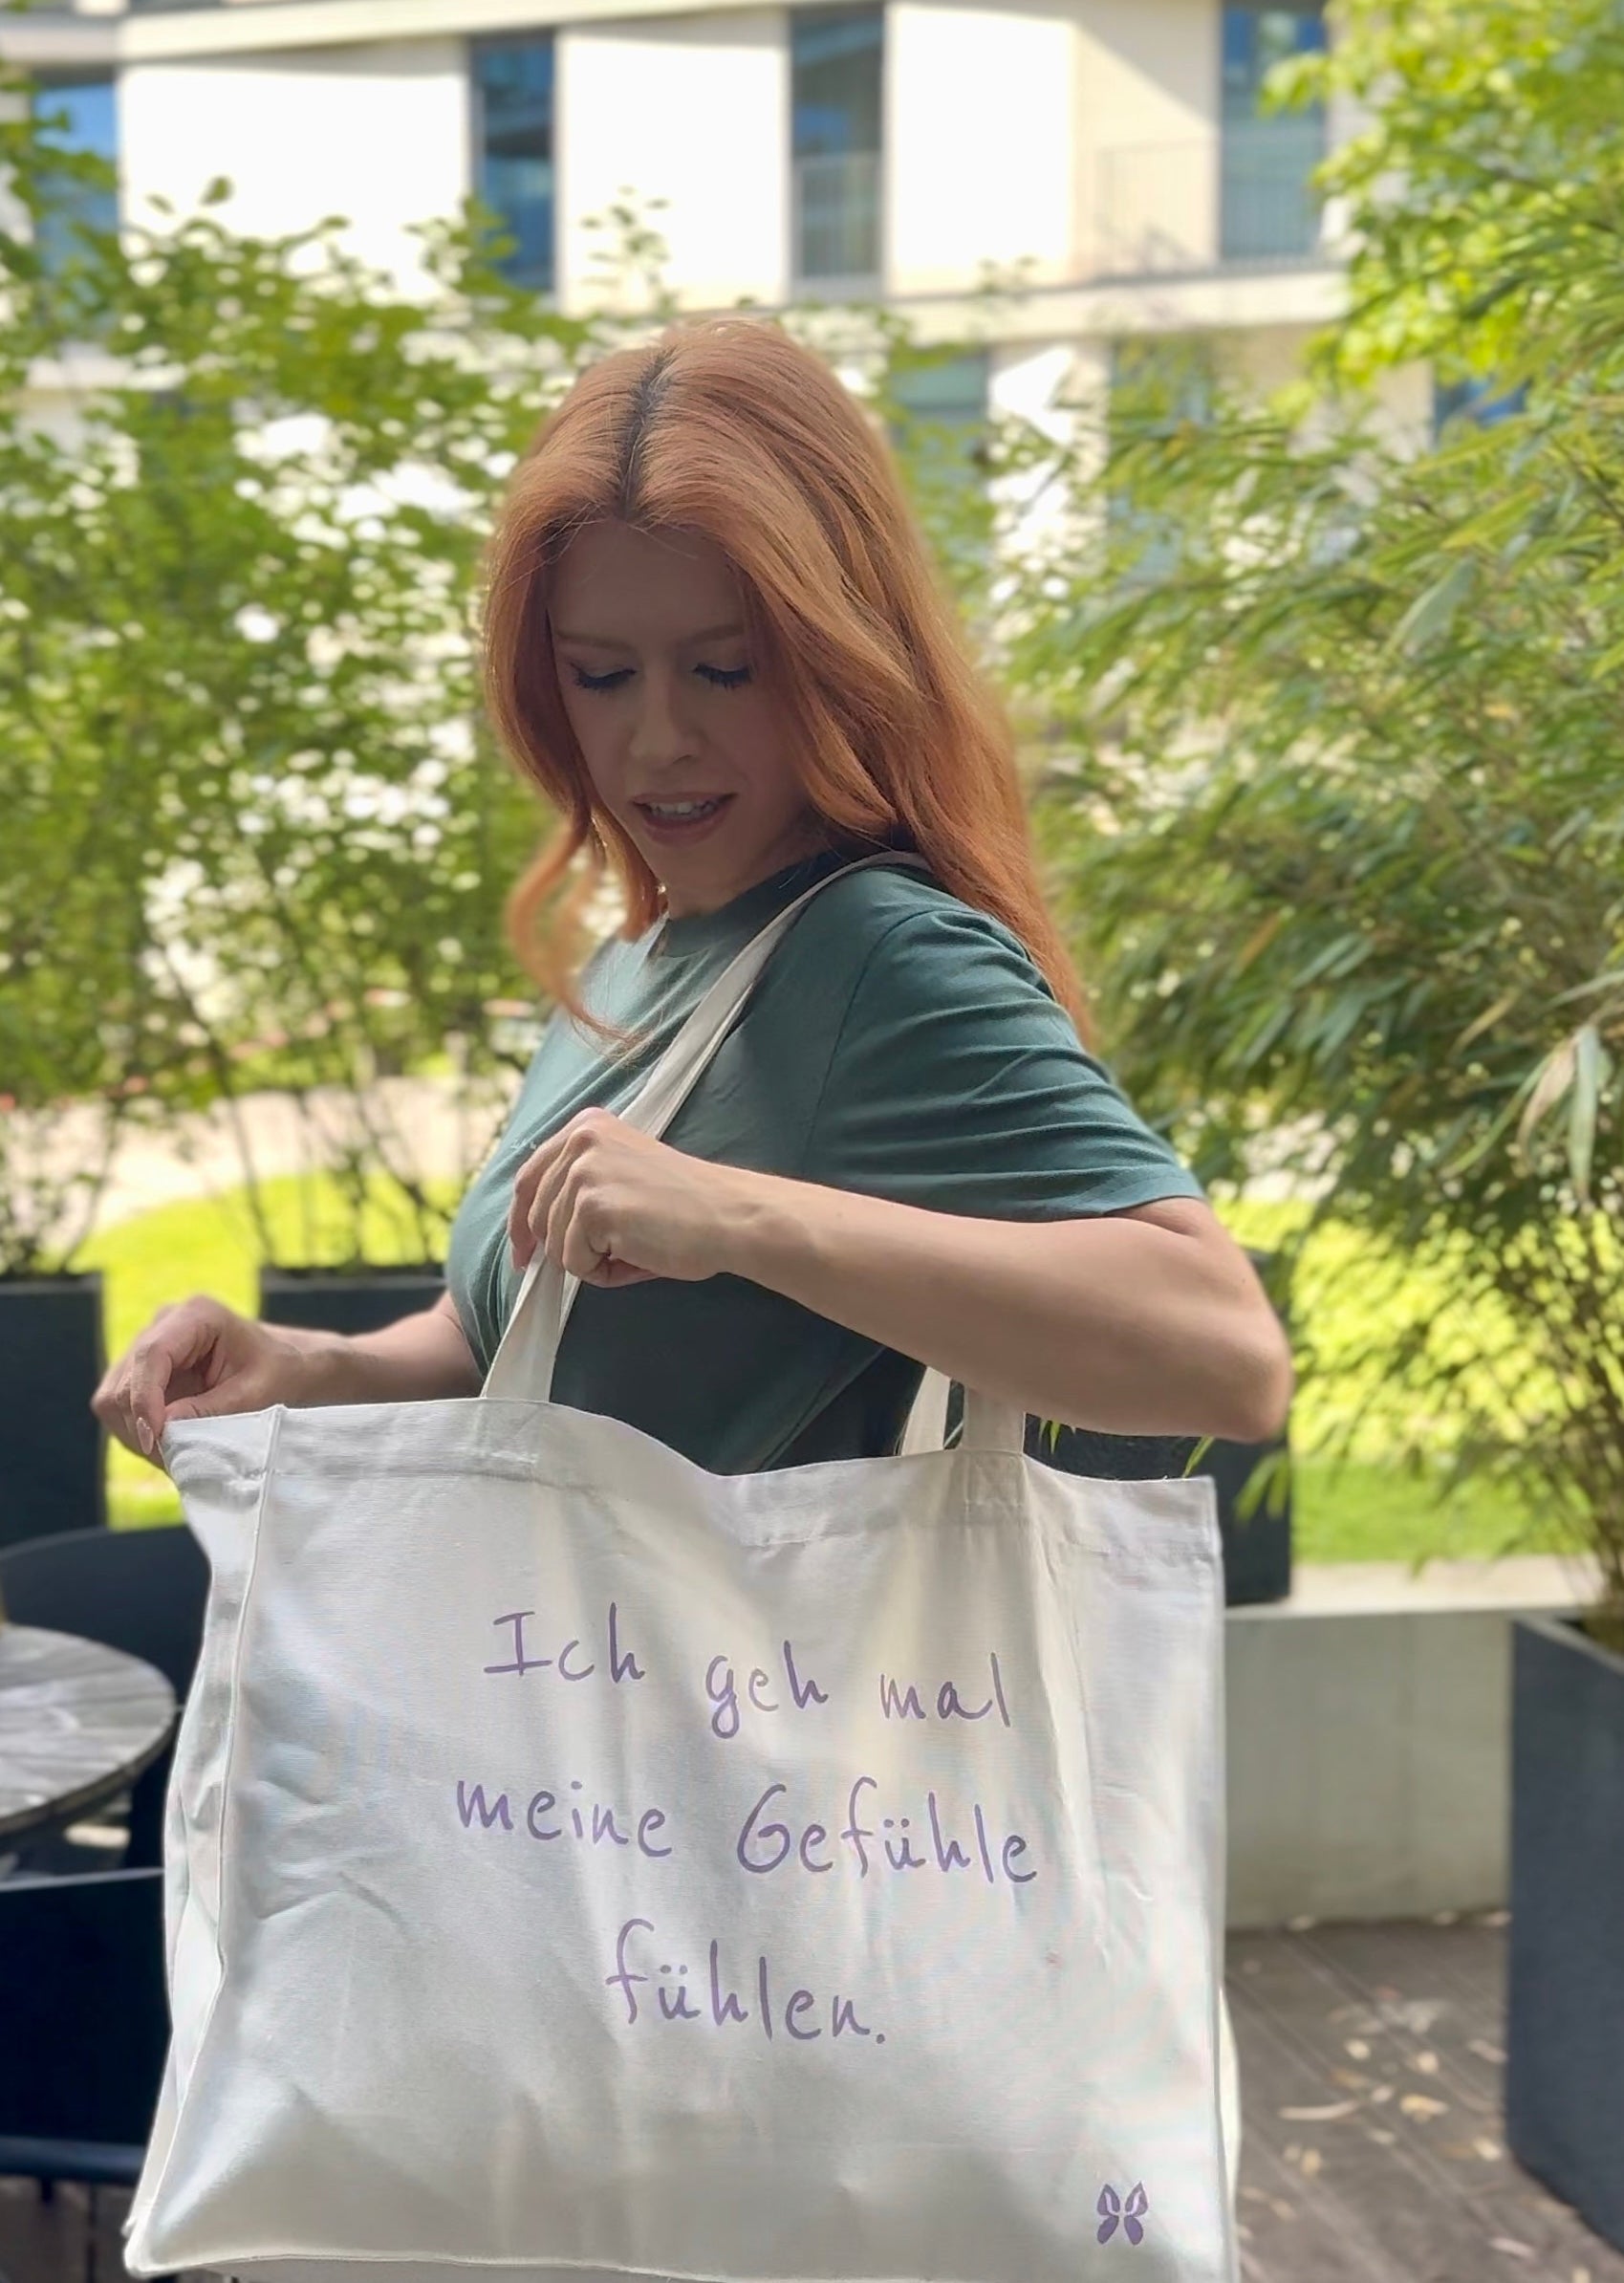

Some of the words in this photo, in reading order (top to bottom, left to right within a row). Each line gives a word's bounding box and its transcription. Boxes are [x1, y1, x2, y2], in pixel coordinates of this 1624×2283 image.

[484, 1602, 646, 1684] Ich
[704, 1640, 829, 1739] geh
[879, 1652, 1011, 1729] mal
[456, 1780, 673, 1858] meine
[736, 1776, 1038, 1883] Gefühle
[606, 1918, 886, 2045] fühlen.
